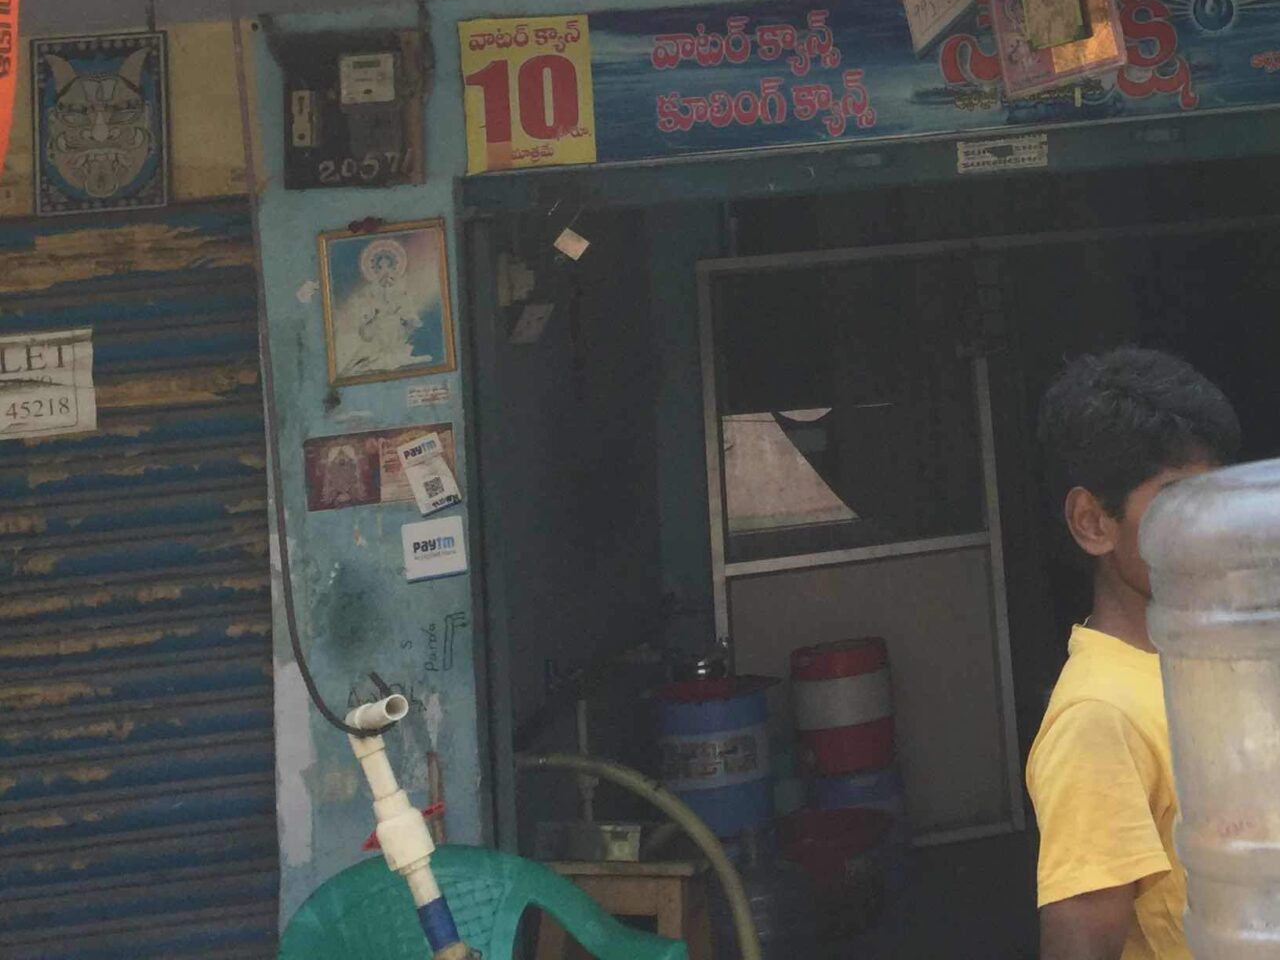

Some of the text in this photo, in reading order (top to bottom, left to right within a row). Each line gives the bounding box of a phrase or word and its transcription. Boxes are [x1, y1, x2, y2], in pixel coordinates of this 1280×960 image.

[468, 19, 581, 53] వాటర్ క్యాన్
[651, 8, 843, 77] వాటర్ క్యాన్స్
[465, 53, 580, 144] 10
[656, 76, 788, 133] కూలింగ్
[791, 67, 878, 138] క్యాన్స్
[5, 396, 71, 420] 45218
